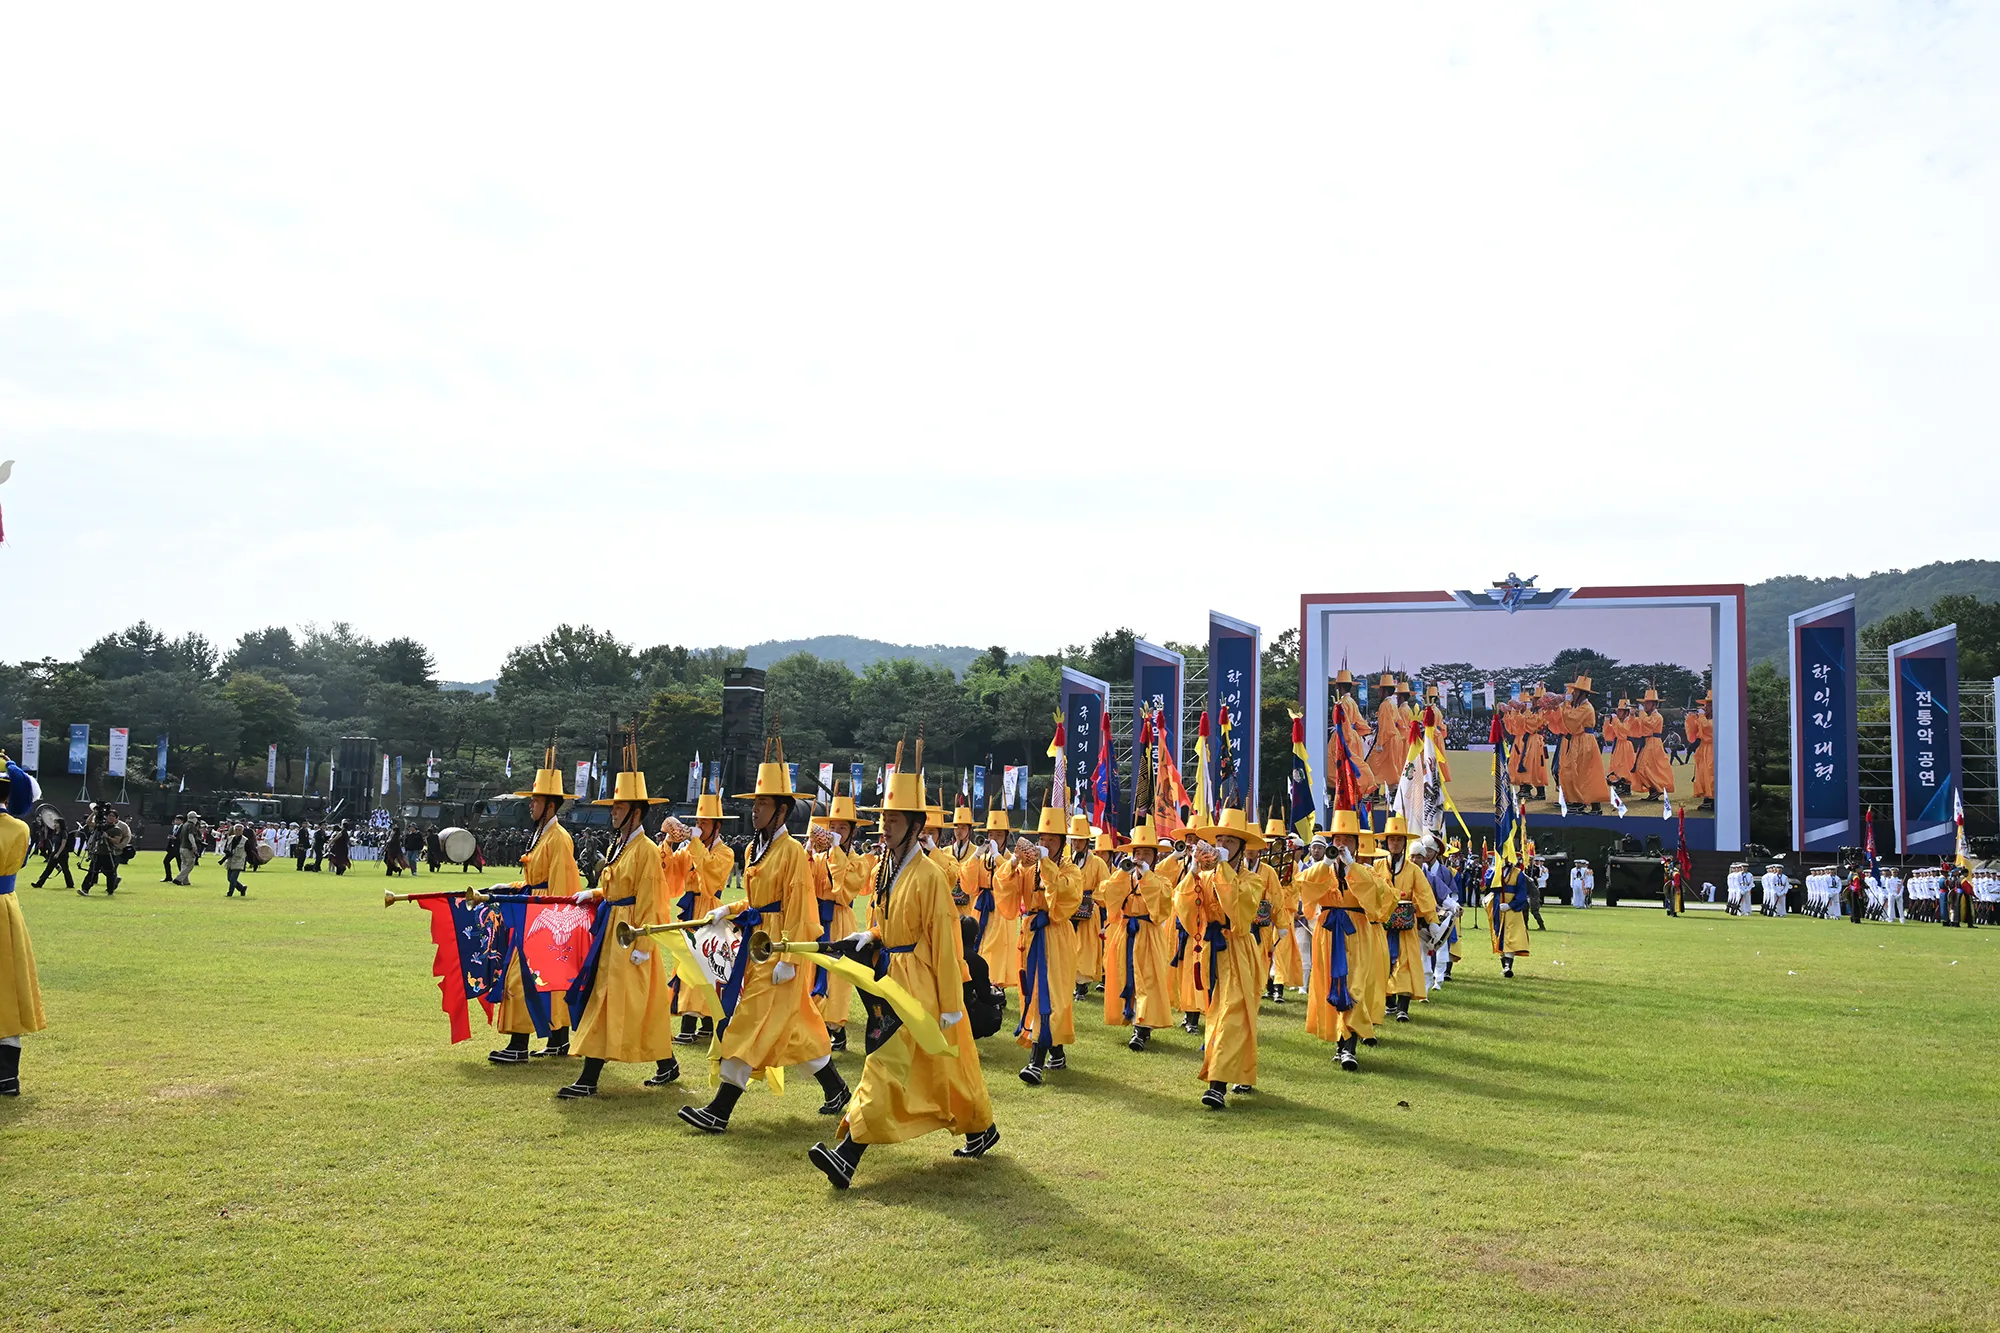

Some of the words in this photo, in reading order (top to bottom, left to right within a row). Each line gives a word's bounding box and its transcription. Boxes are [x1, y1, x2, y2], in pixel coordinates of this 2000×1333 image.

[1227, 669, 1242, 727] 학익진
[1811, 663, 1833, 729] 학익진
[1915, 690, 1934, 745] 전통악
[1078, 705, 1089, 752] 국민의
[1076, 760, 1088, 790] 군대
[1813, 741, 1834, 782] 대형
[1917, 751, 1935, 787] 공연
